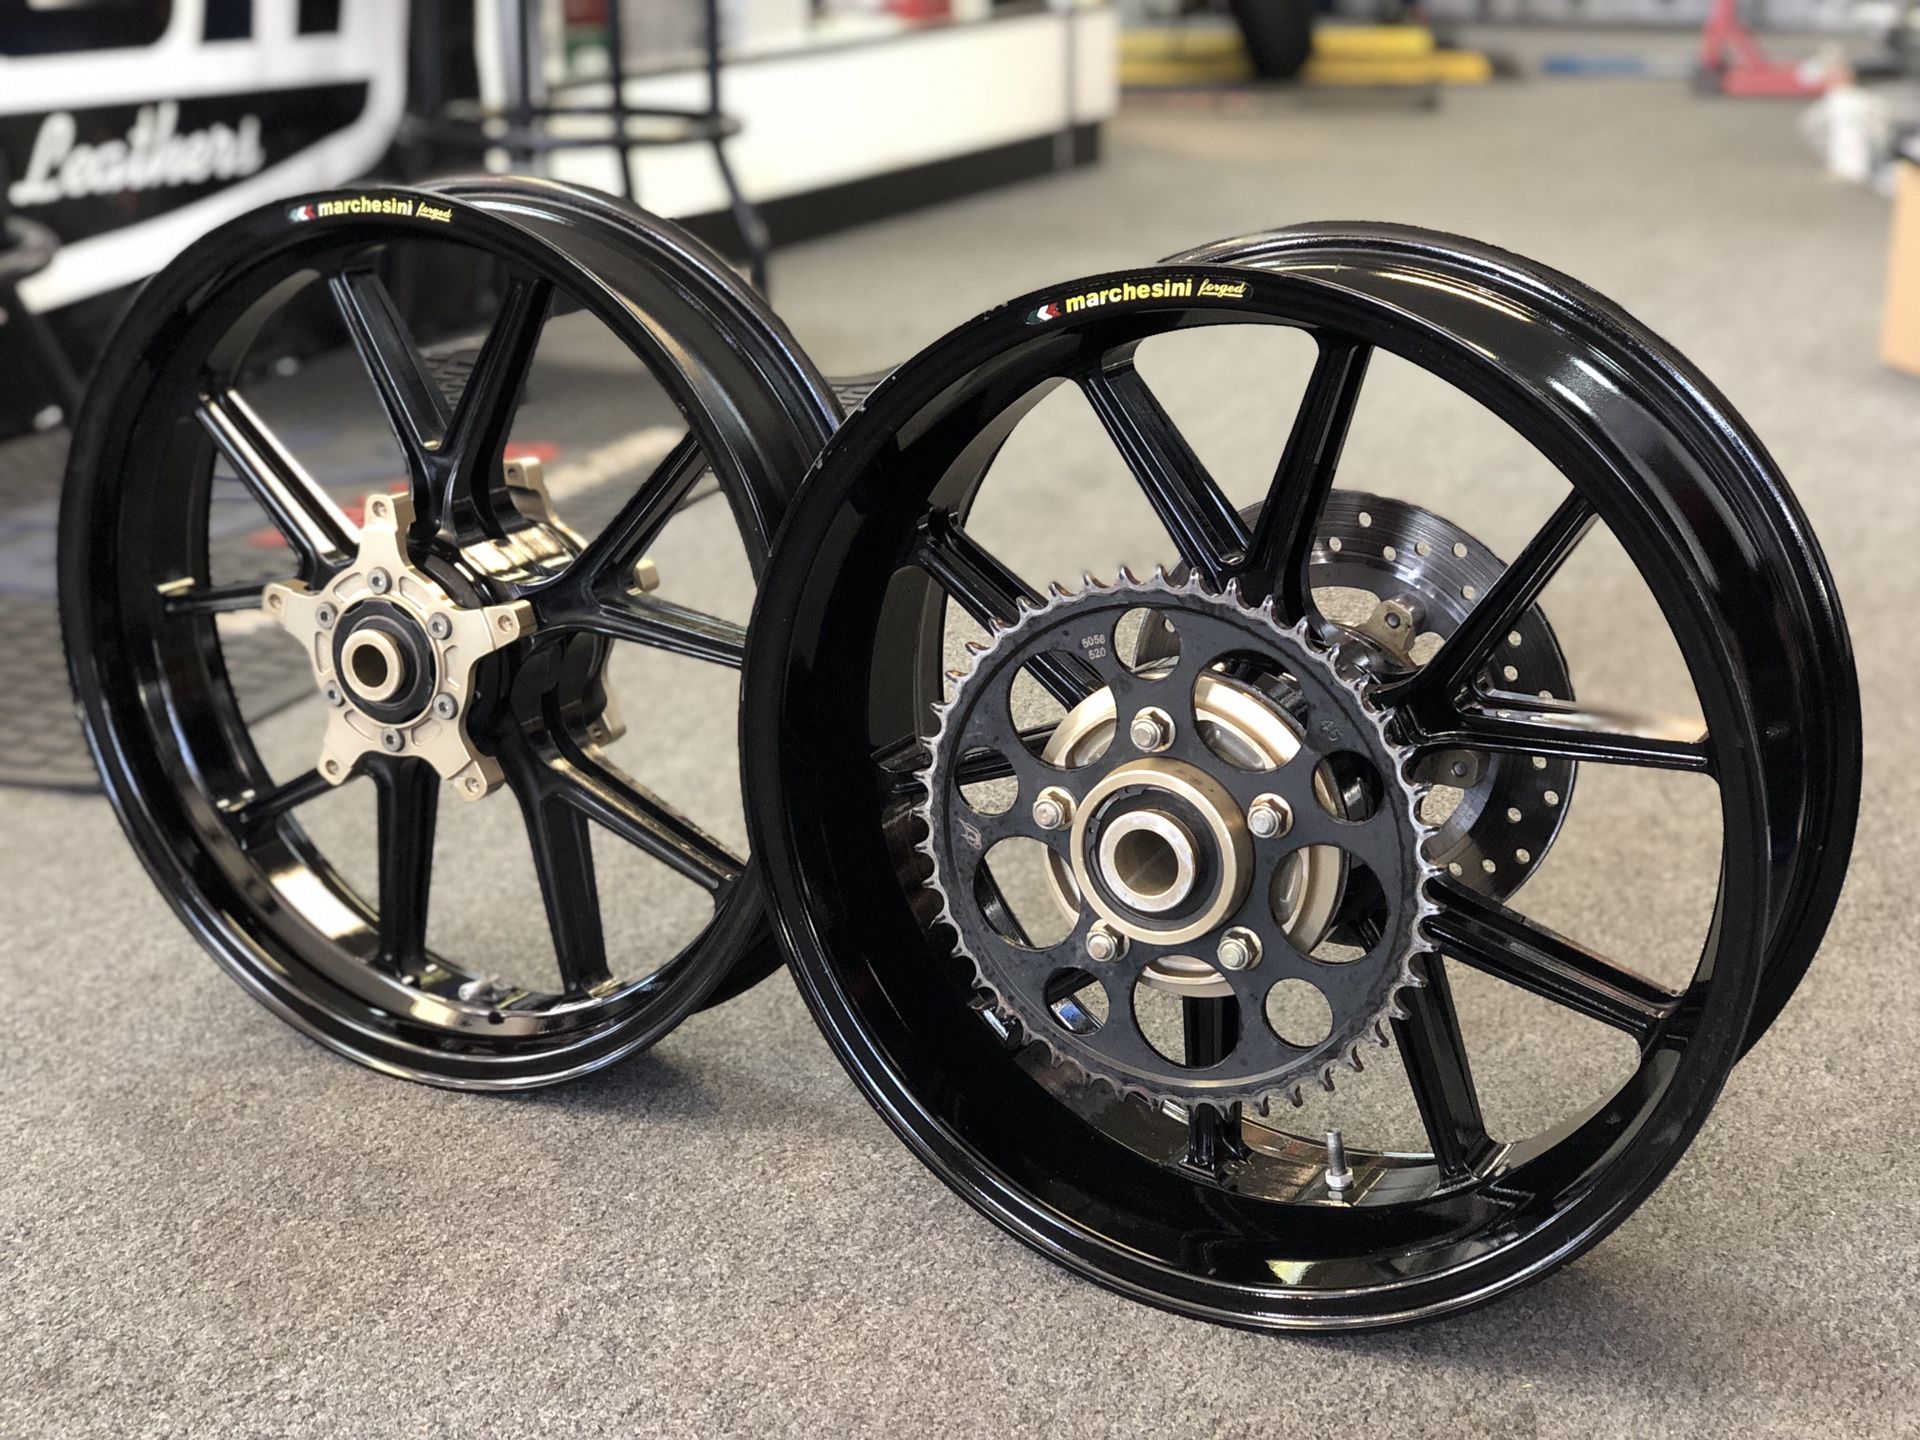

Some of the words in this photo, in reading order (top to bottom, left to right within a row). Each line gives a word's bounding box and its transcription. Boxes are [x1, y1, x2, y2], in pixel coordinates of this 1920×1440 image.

[8, 101, 264, 206] Leathers
[318, 196, 412, 217] marchesini
[416, 202, 452, 223] forged
[1065, 279, 1192, 313] marchesini
[1198, 278, 1246, 298] forged
